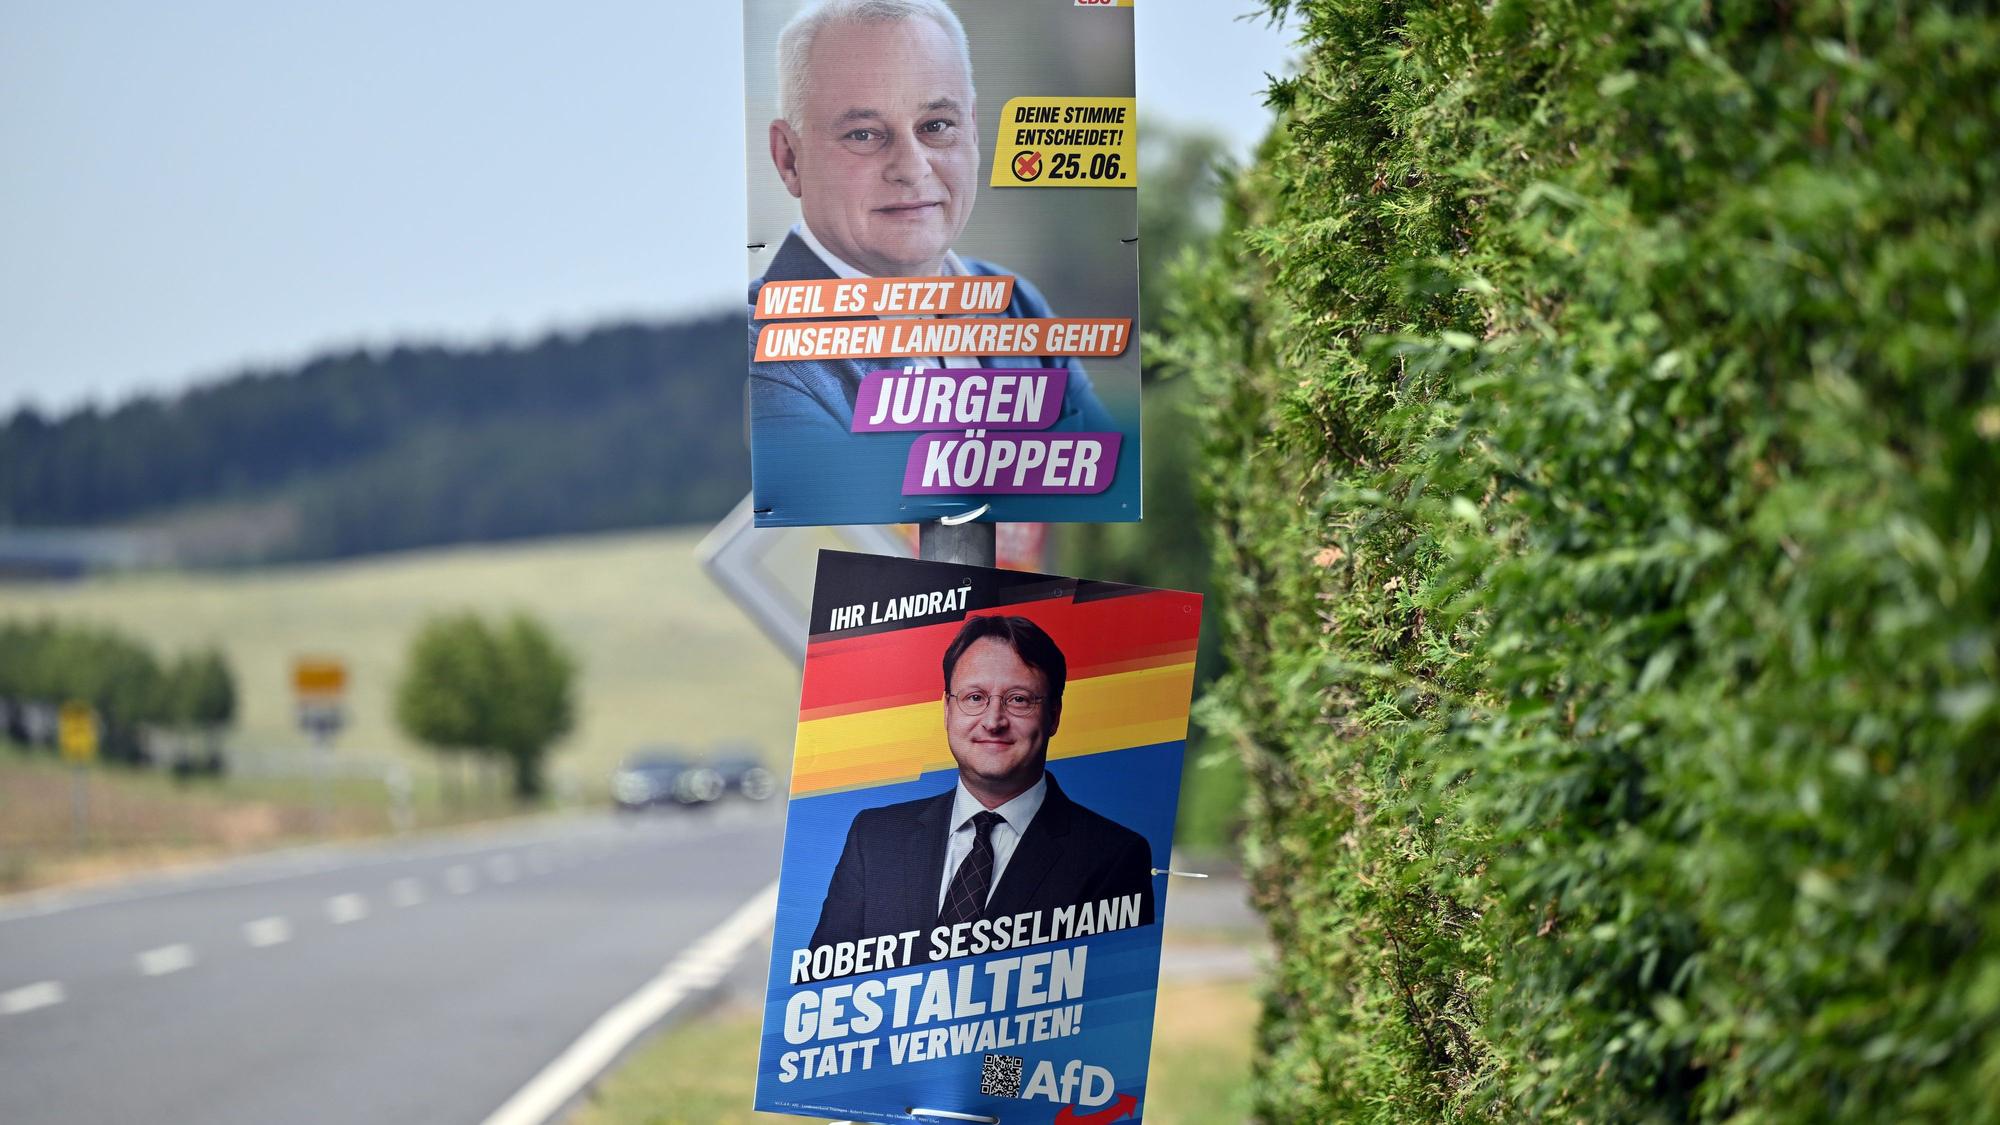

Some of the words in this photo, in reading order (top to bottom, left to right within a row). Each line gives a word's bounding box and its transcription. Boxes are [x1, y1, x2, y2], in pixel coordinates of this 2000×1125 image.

[1014, 106, 1061, 123] DEINE
[1063, 107, 1126, 124] STIMME
[1015, 129, 1123, 146] ENTSCHEIDET!
[1048, 153, 1127, 180] 25.06.
[764, 285, 825, 315] WEIL
[833, 283, 868, 313] ES
[873, 282, 955, 312] JETZT
[960, 281, 1006, 310] UM
[764, 326, 884, 358] UNSEREN
[891, 323, 1038, 353] LANDKREIS
[1045, 322, 1124, 352] GEHT!
[869, 365, 1049, 425] JÜRGEN
[921, 428, 1102, 487] KÖPPER
[829, 603, 866, 631] IHR
[870, 585, 972, 625] LANDRAT
[789, 930, 921, 985] ROBERT
[928, 893, 1142, 962] SESSELMANN
[783, 945, 1089, 1046] GESTALTEN
[778, 1038, 880, 1084] STATT
[888, 1004, 1083, 1067] VERWALTEN!
[1021, 1059, 1116, 1107] AfD
